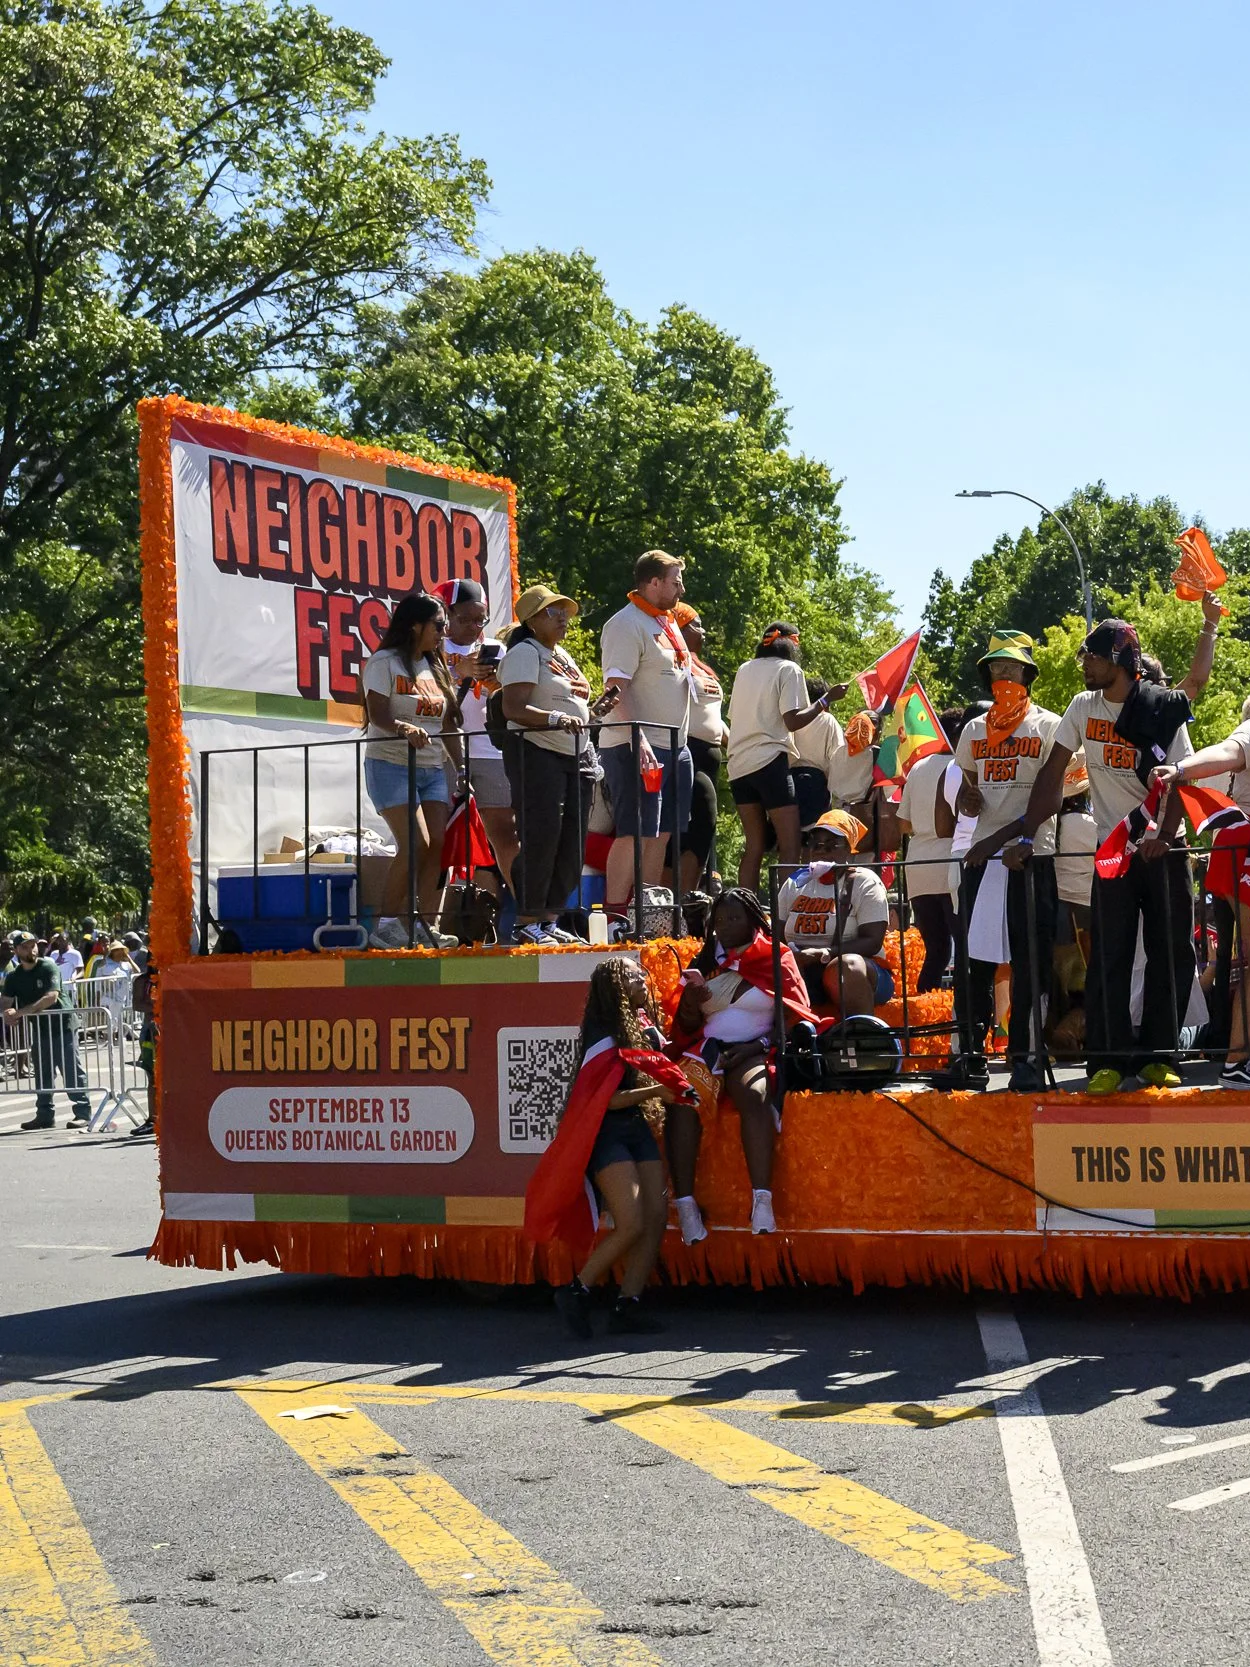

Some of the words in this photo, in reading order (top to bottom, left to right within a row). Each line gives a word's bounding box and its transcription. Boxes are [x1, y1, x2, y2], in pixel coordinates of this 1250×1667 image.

[208, 455, 489, 604] NEIGHBOR
[294, 586, 400, 704] FES
[984, 758, 1019, 782] FEST
[1103, 744, 1138, 770] FEST
[794, 914, 829, 934] FEST
[211, 1018, 378, 1073] NEIGHBOR
[390, 1016, 472, 1071] FEST
[268, 1098, 384, 1123] SEPTEMBER
[389, 1097, 410, 1123] 13
[224, 1130, 287, 1153] QUEENS
[292, 1129, 385, 1152] BOTANICAL
[390, 1129, 457, 1152] GARDEN
[1071, 1146, 1131, 1183] THIS
[1139, 1146, 1165, 1183] IS
